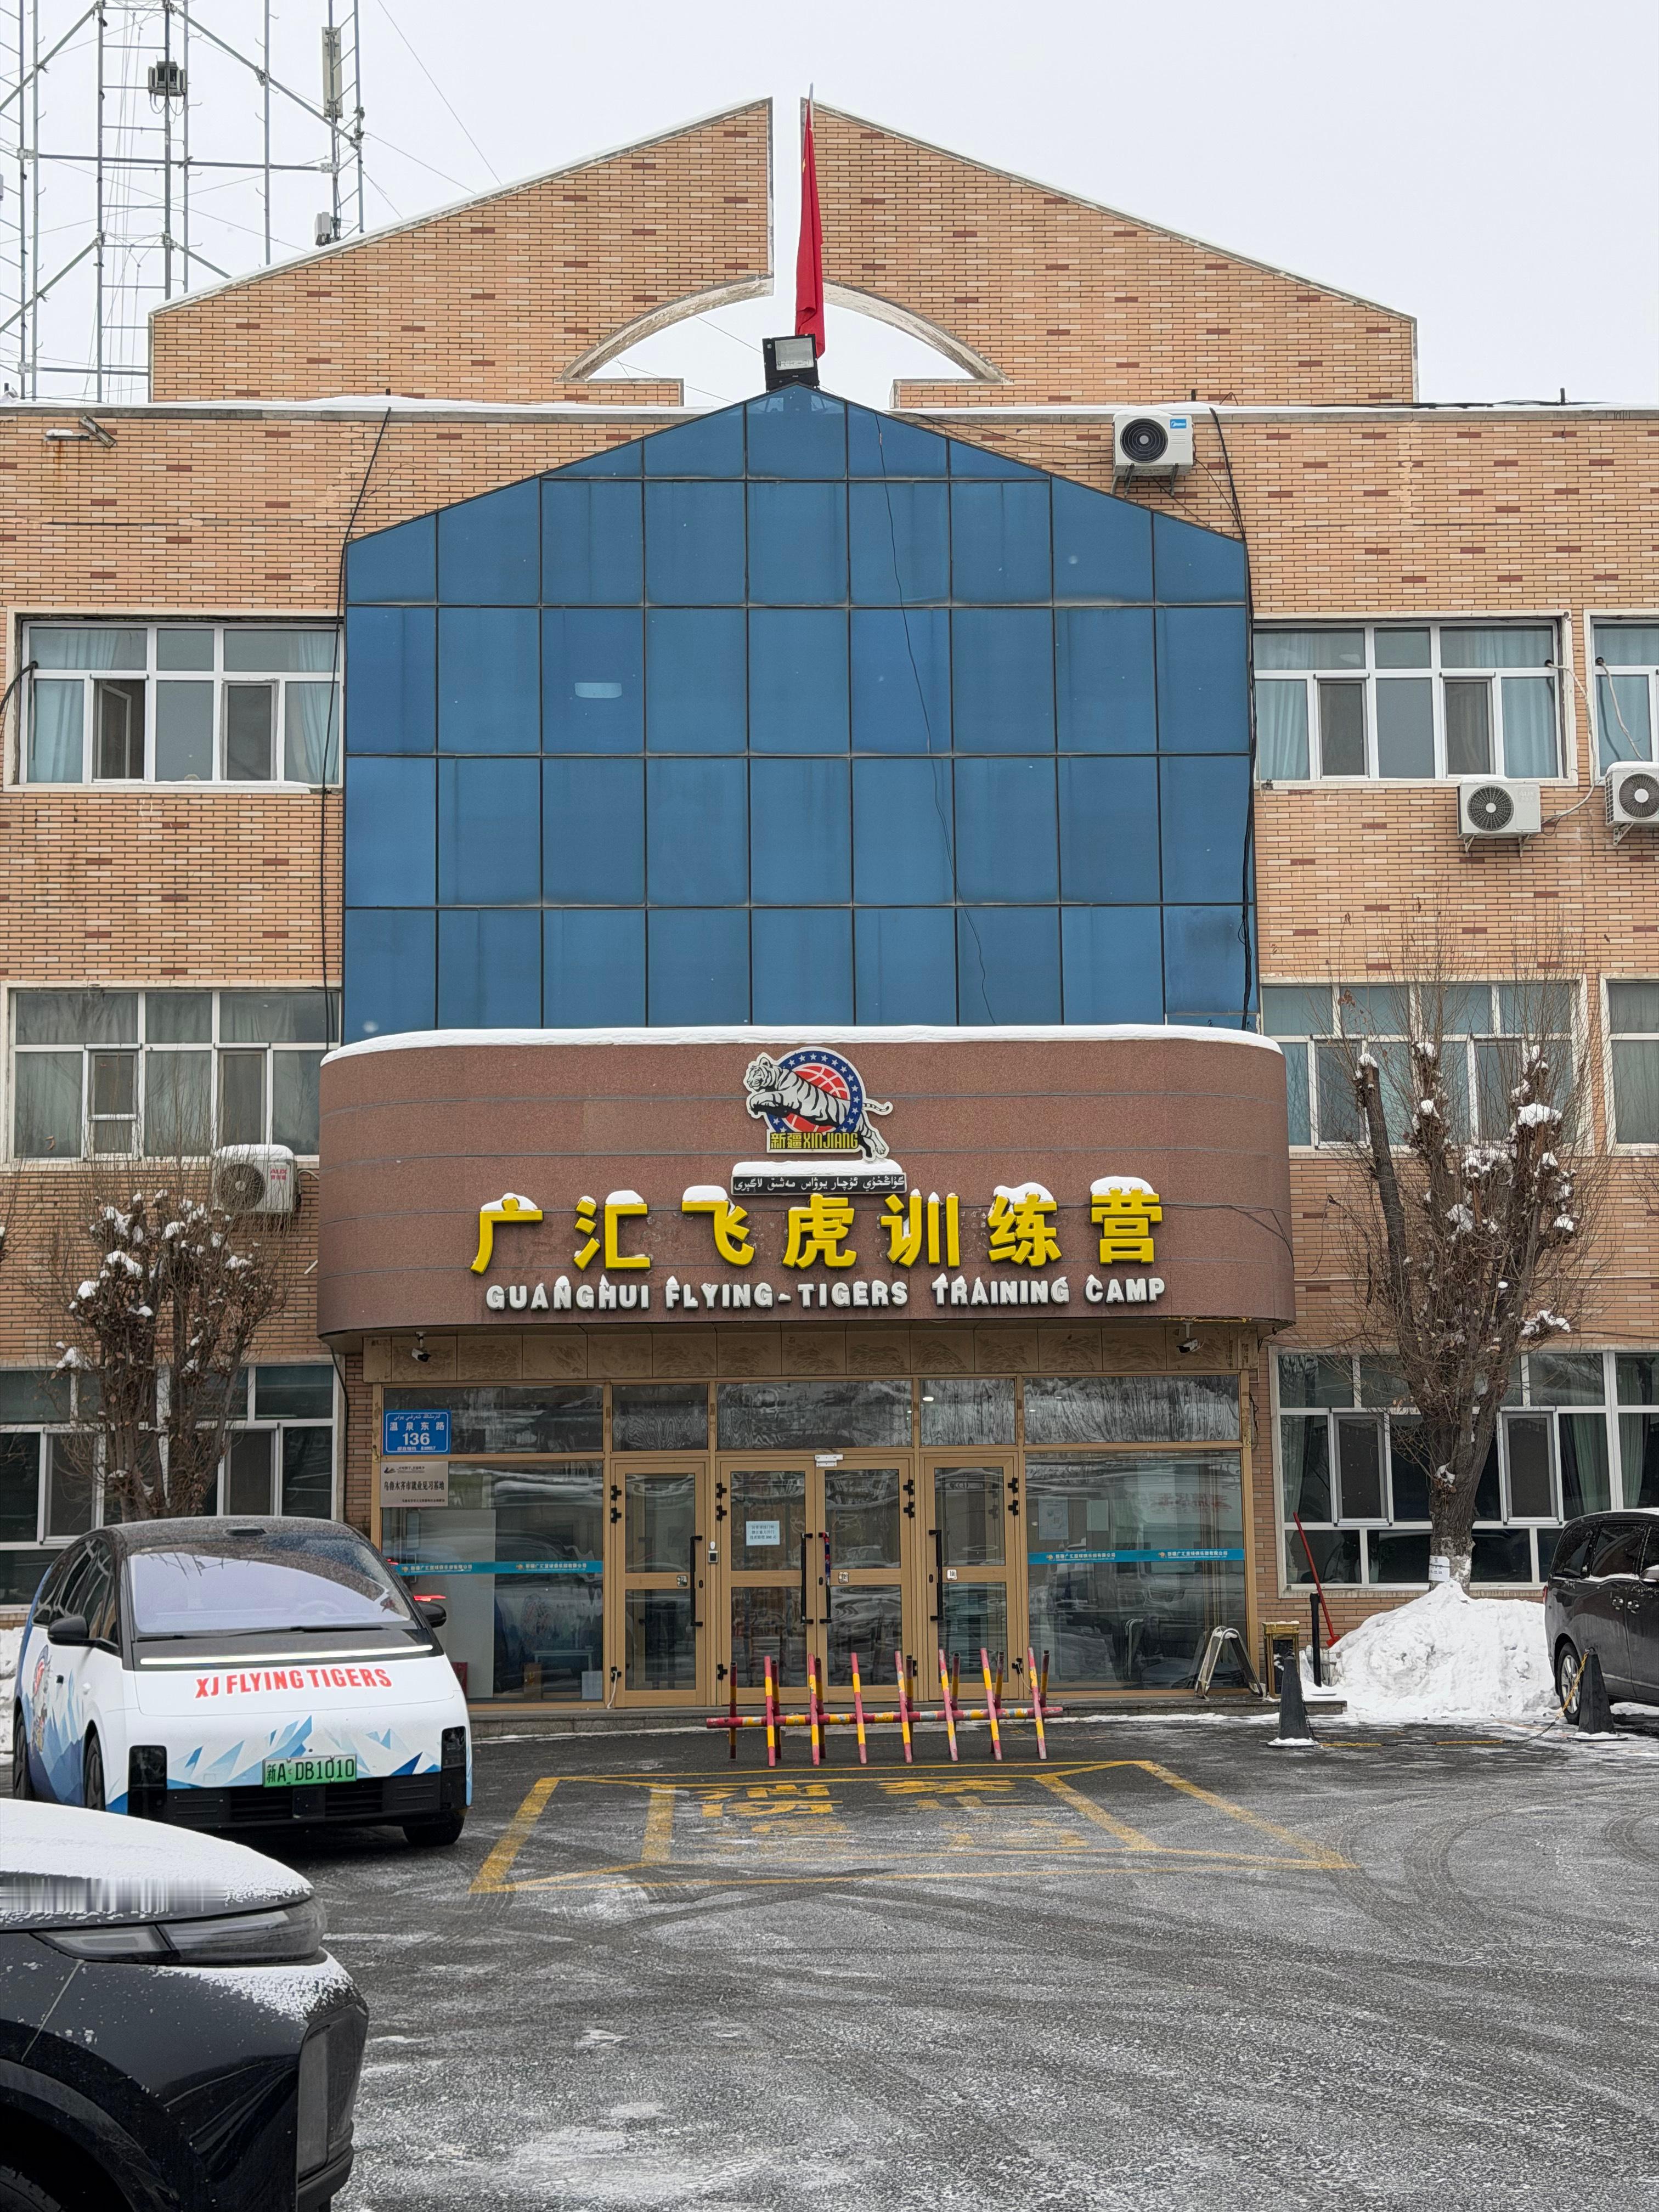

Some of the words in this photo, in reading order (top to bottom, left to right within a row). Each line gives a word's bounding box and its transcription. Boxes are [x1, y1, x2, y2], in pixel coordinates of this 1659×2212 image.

[771, 1132, 802, 1149] 新疆
[803, 1132, 858, 1149] XINJIANG
[470, 1187, 1163, 1275] 广汇飞虎训练营
[486, 1284, 649, 1310] GUANGHUI
[933, 1278, 1070, 1306] TRAINING
[1084, 1277, 1165, 1304] CAMP
[390, 1421, 445, 1431] 温泉东路
[402, 1432, 430, 1446] 136
[384, 1481, 445, 1491] 乌鲁木齐市就业见习基地
[195, 1676, 219, 1699] XJ
[227, 1670, 304, 1694] FLYING
[307, 1668, 392, 1688] TIGERS
[267, 1763, 286, 1783] 新A
[295, 1758, 354, 1781] DB1010
